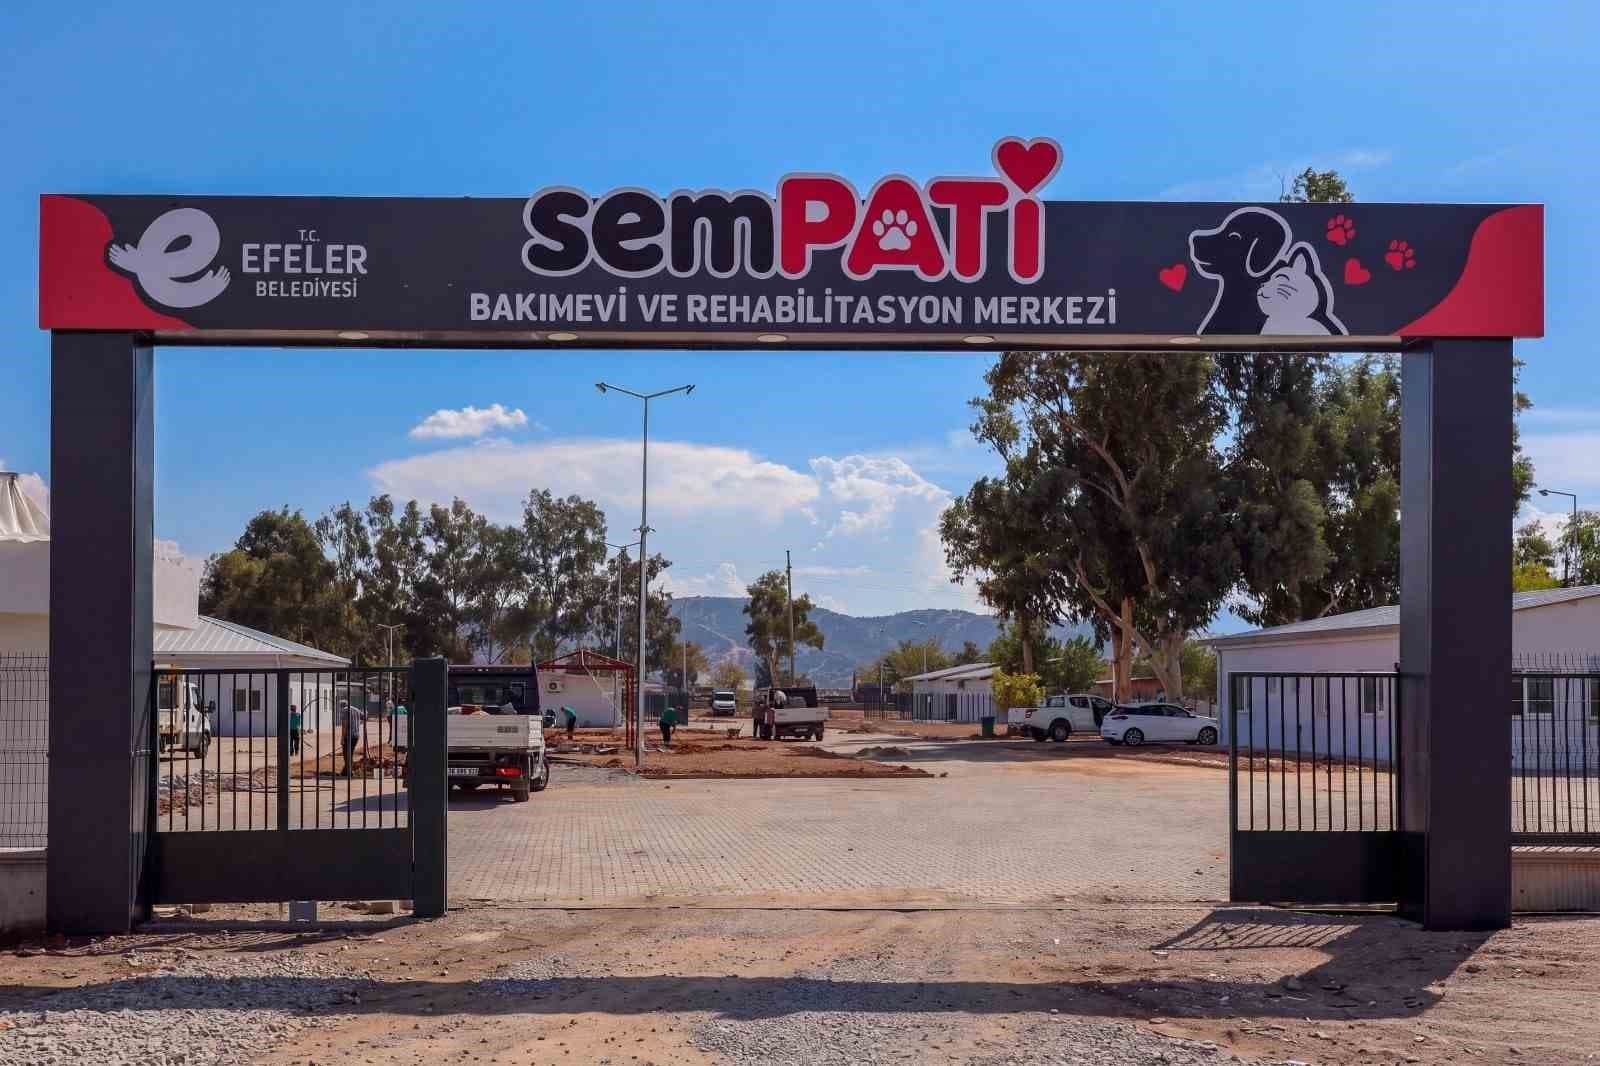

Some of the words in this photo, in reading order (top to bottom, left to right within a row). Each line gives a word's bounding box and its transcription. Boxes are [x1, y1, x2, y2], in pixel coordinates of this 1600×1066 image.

[298, 229, 321, 242] T.C.
[242, 243, 368, 274] EFELER
[256, 278, 357, 298] BELEDİYESİ
[470, 286, 627, 322] BAKIMEVİ
[637, 294, 678, 322] VE
[687, 288, 963, 324] REHABİLİTASYON
[974, 288, 1117, 325] MERKEZİ
